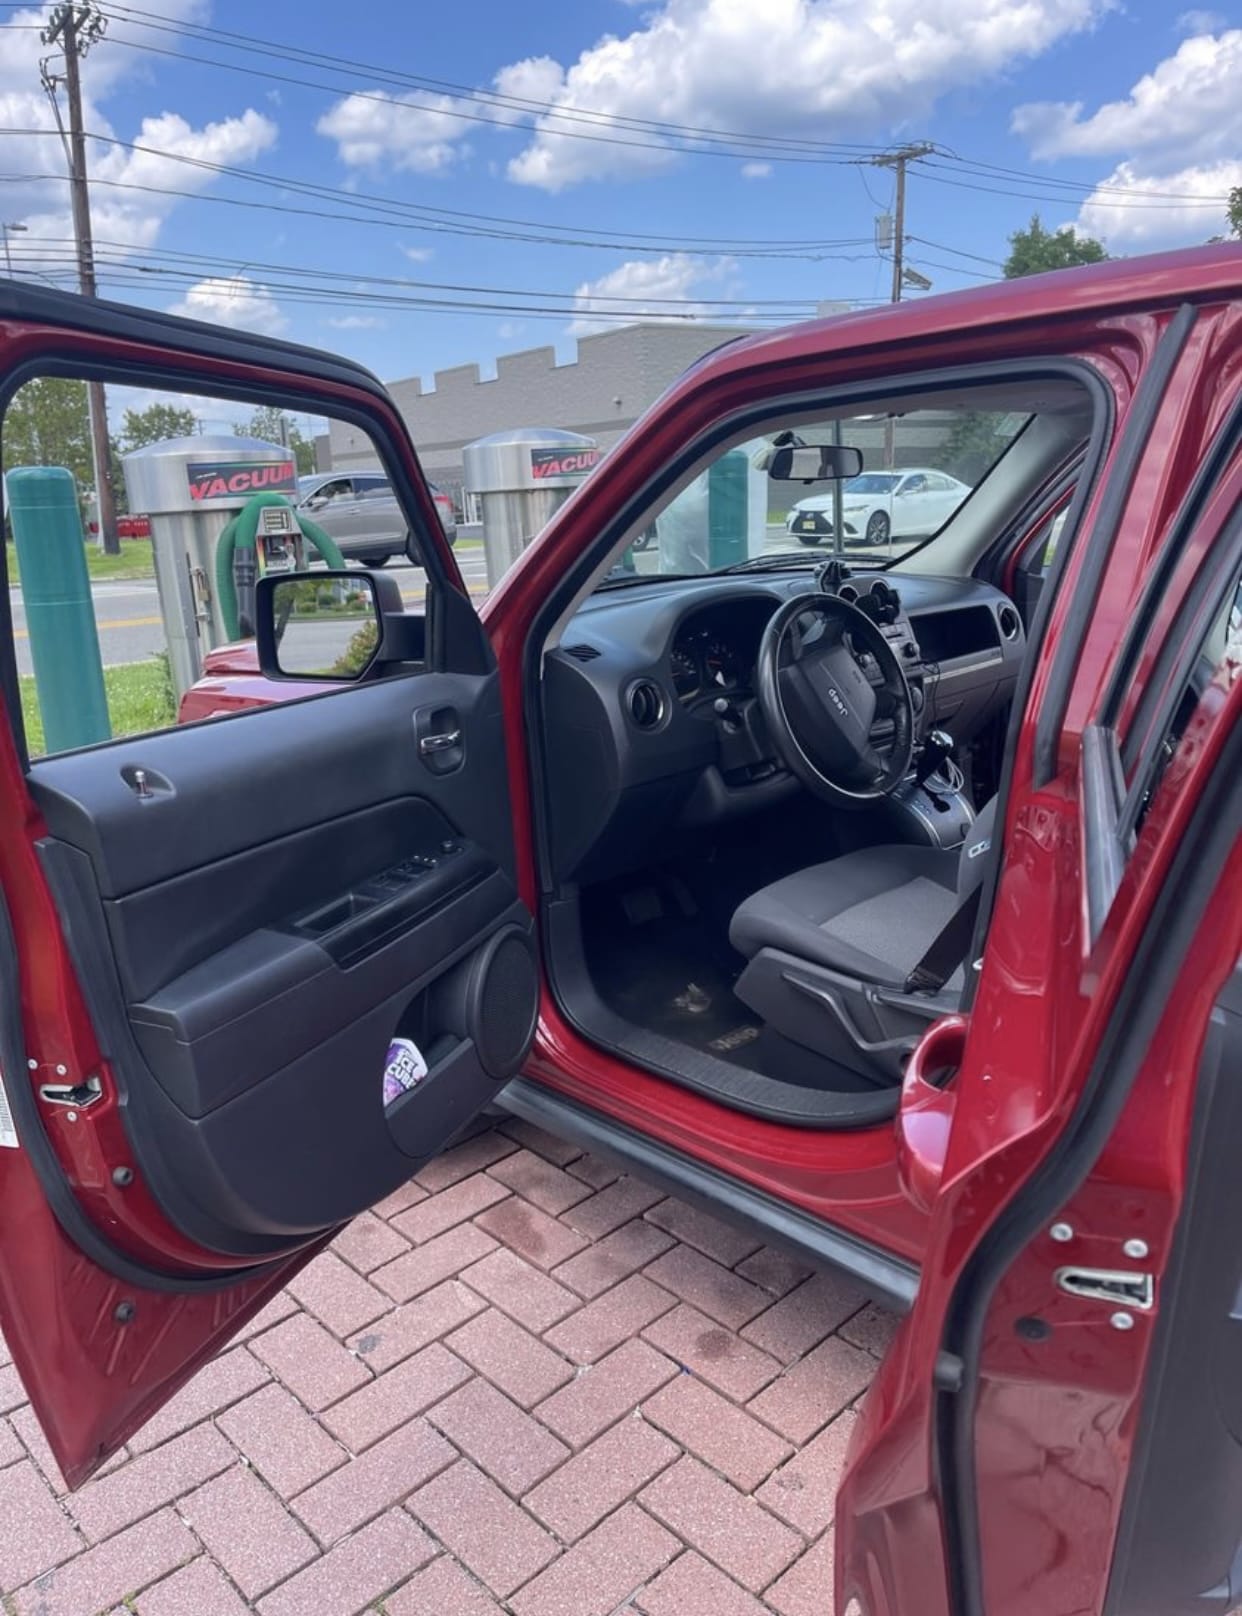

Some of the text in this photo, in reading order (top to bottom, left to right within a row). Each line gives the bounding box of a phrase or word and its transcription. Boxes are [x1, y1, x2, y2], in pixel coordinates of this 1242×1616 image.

[532, 451, 601, 479] VACUU
[189, 461, 294, 501] VACUUM
[828, 688, 848, 716] Jeep
